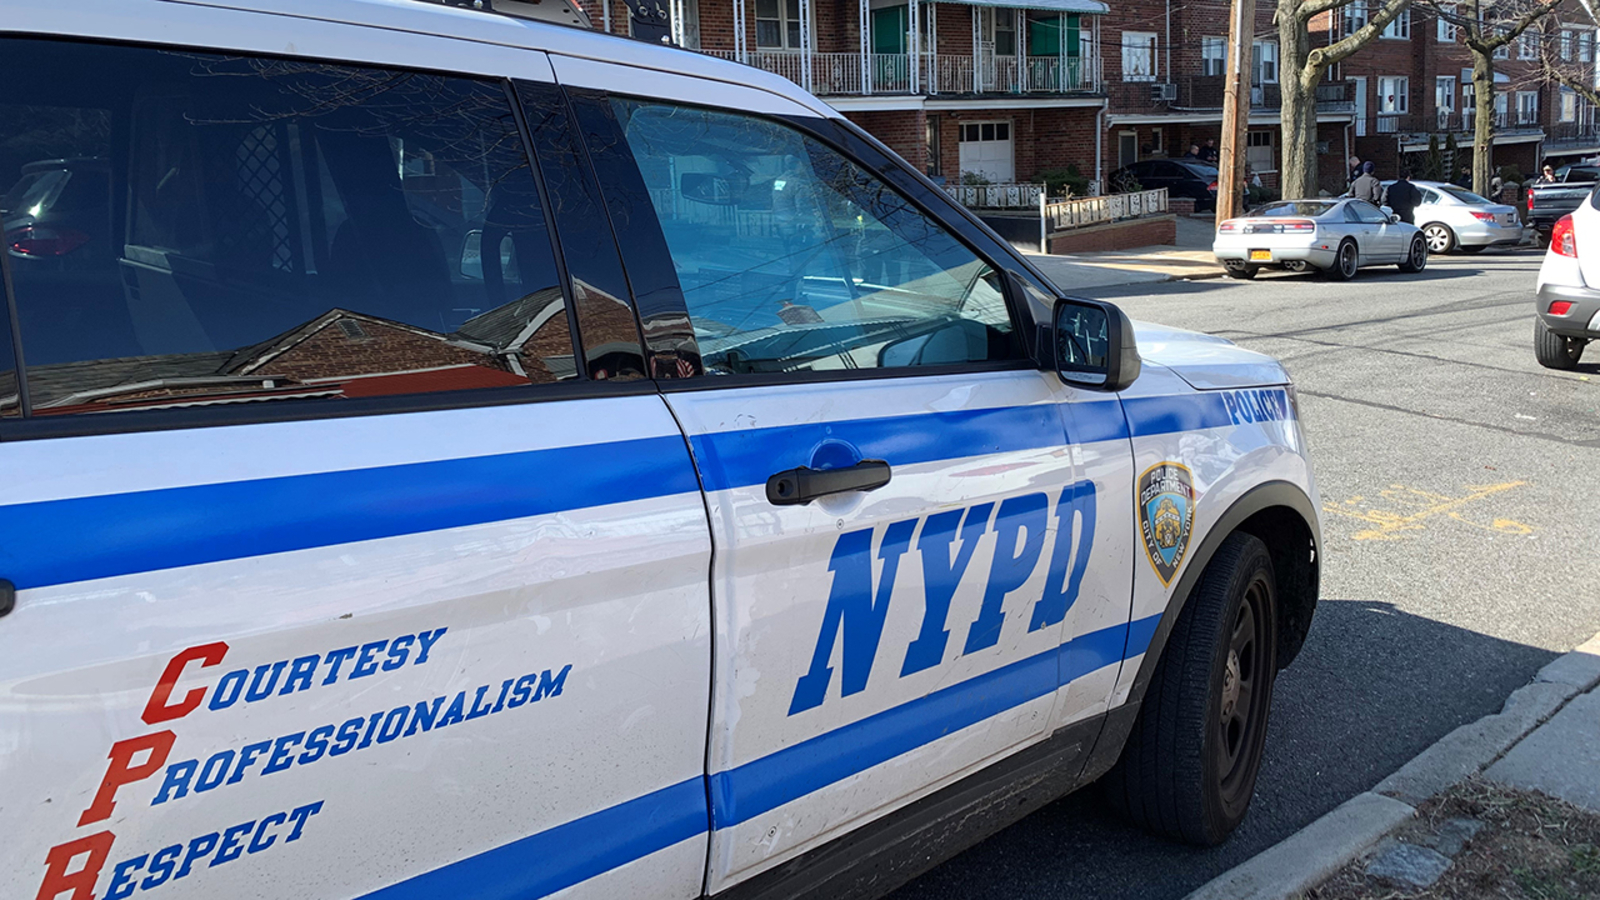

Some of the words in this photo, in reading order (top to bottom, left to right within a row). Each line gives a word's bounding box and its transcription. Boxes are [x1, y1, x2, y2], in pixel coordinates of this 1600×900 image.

[1140, 479, 1190, 506] DEPARTMENT
[1150, 467, 1179, 484] POLICE
[1142, 520, 1154, 548] CITY
[1152, 551, 1163, 565] OF
[1172, 542, 1185, 568] NEW
[1183, 505, 1193, 537] YORK
[787, 479, 1097, 717] NYPD
[141, 627, 448, 725] COURTESY
[76, 664, 572, 828] PROFESSIONALISM
[35, 800, 325, 900] RESPECT
